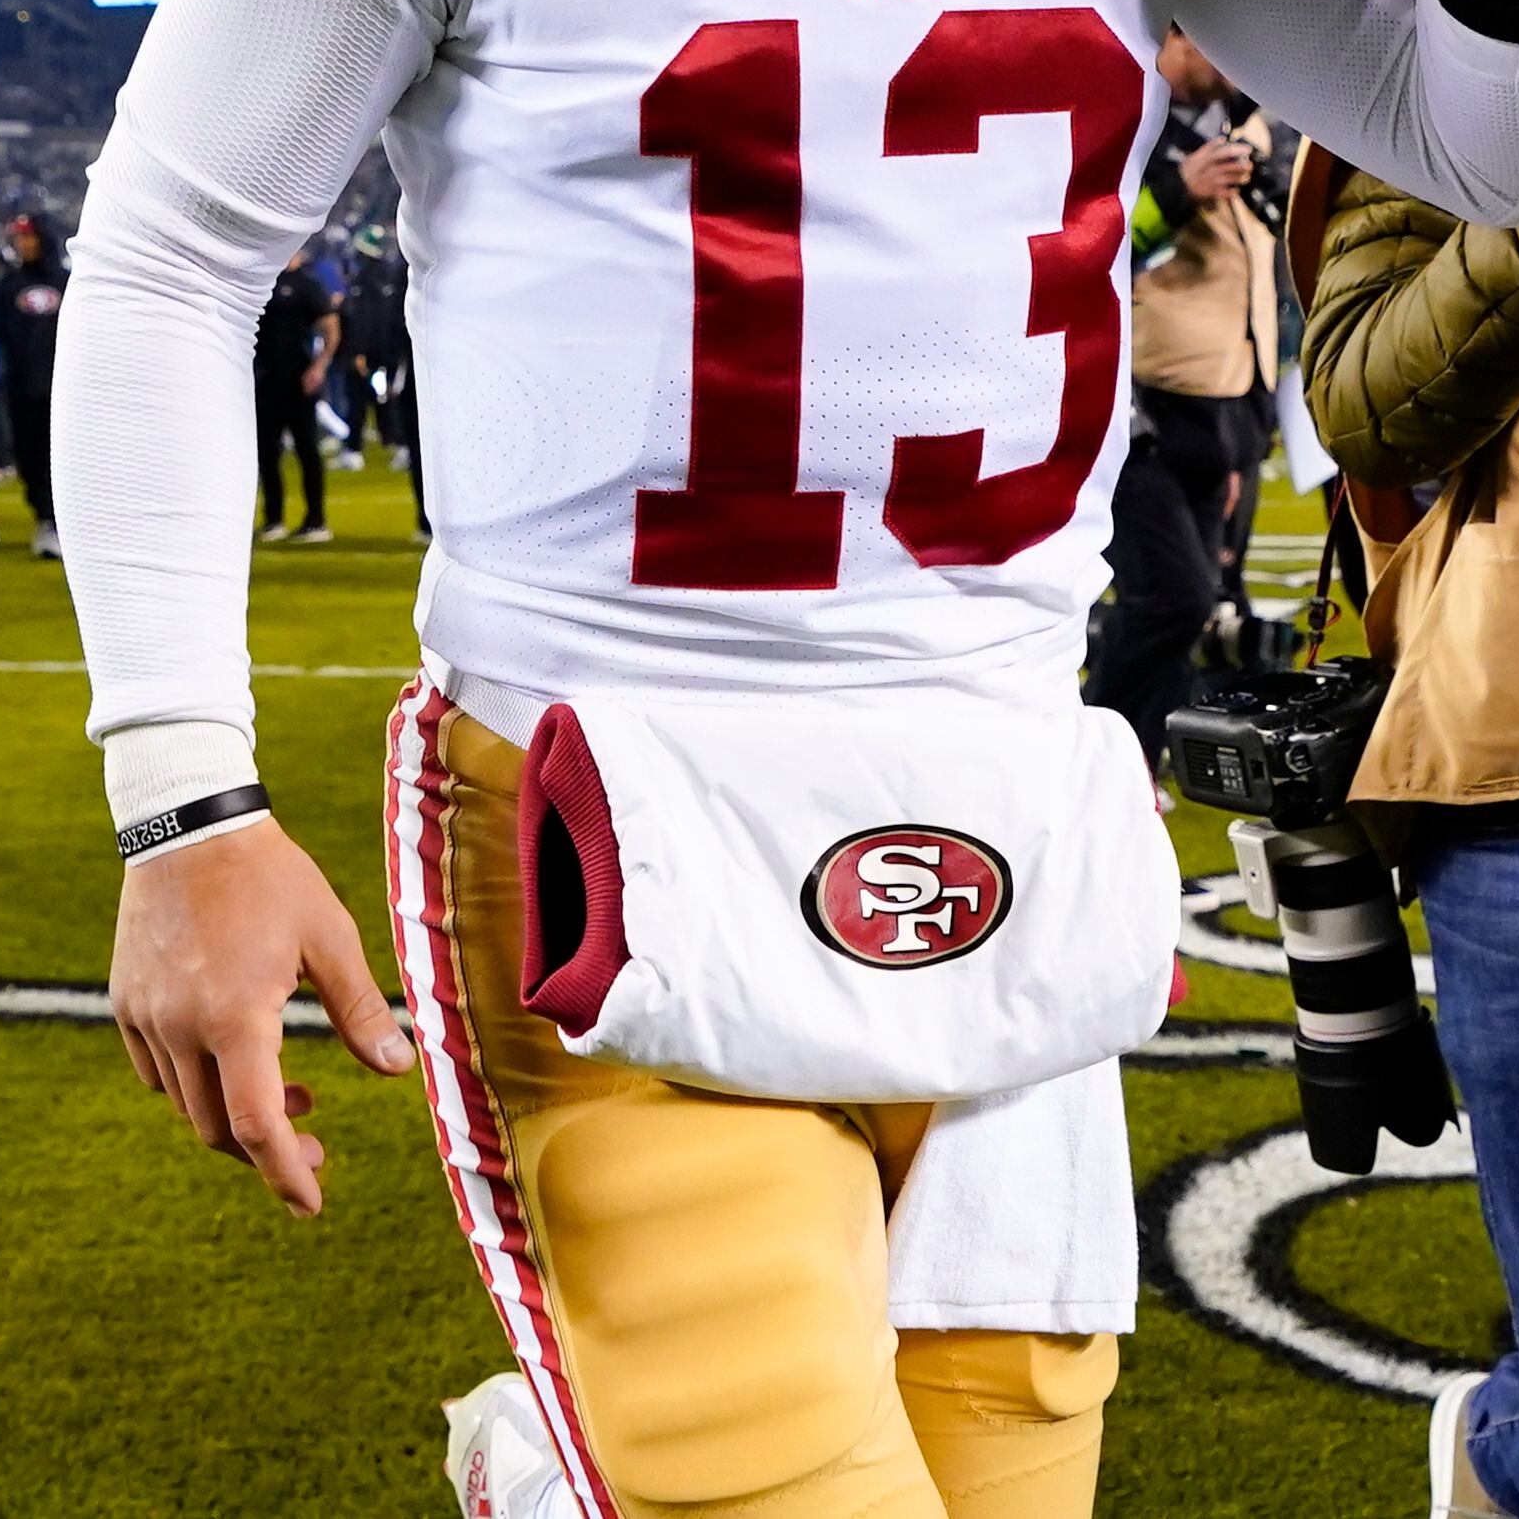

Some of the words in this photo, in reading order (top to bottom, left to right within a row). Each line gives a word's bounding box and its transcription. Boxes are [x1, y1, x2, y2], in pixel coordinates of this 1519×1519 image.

[631, 6, 1145, 590] 13
[117, 810, 183, 857] HS2KC
[855, 843, 981, 954] SF
